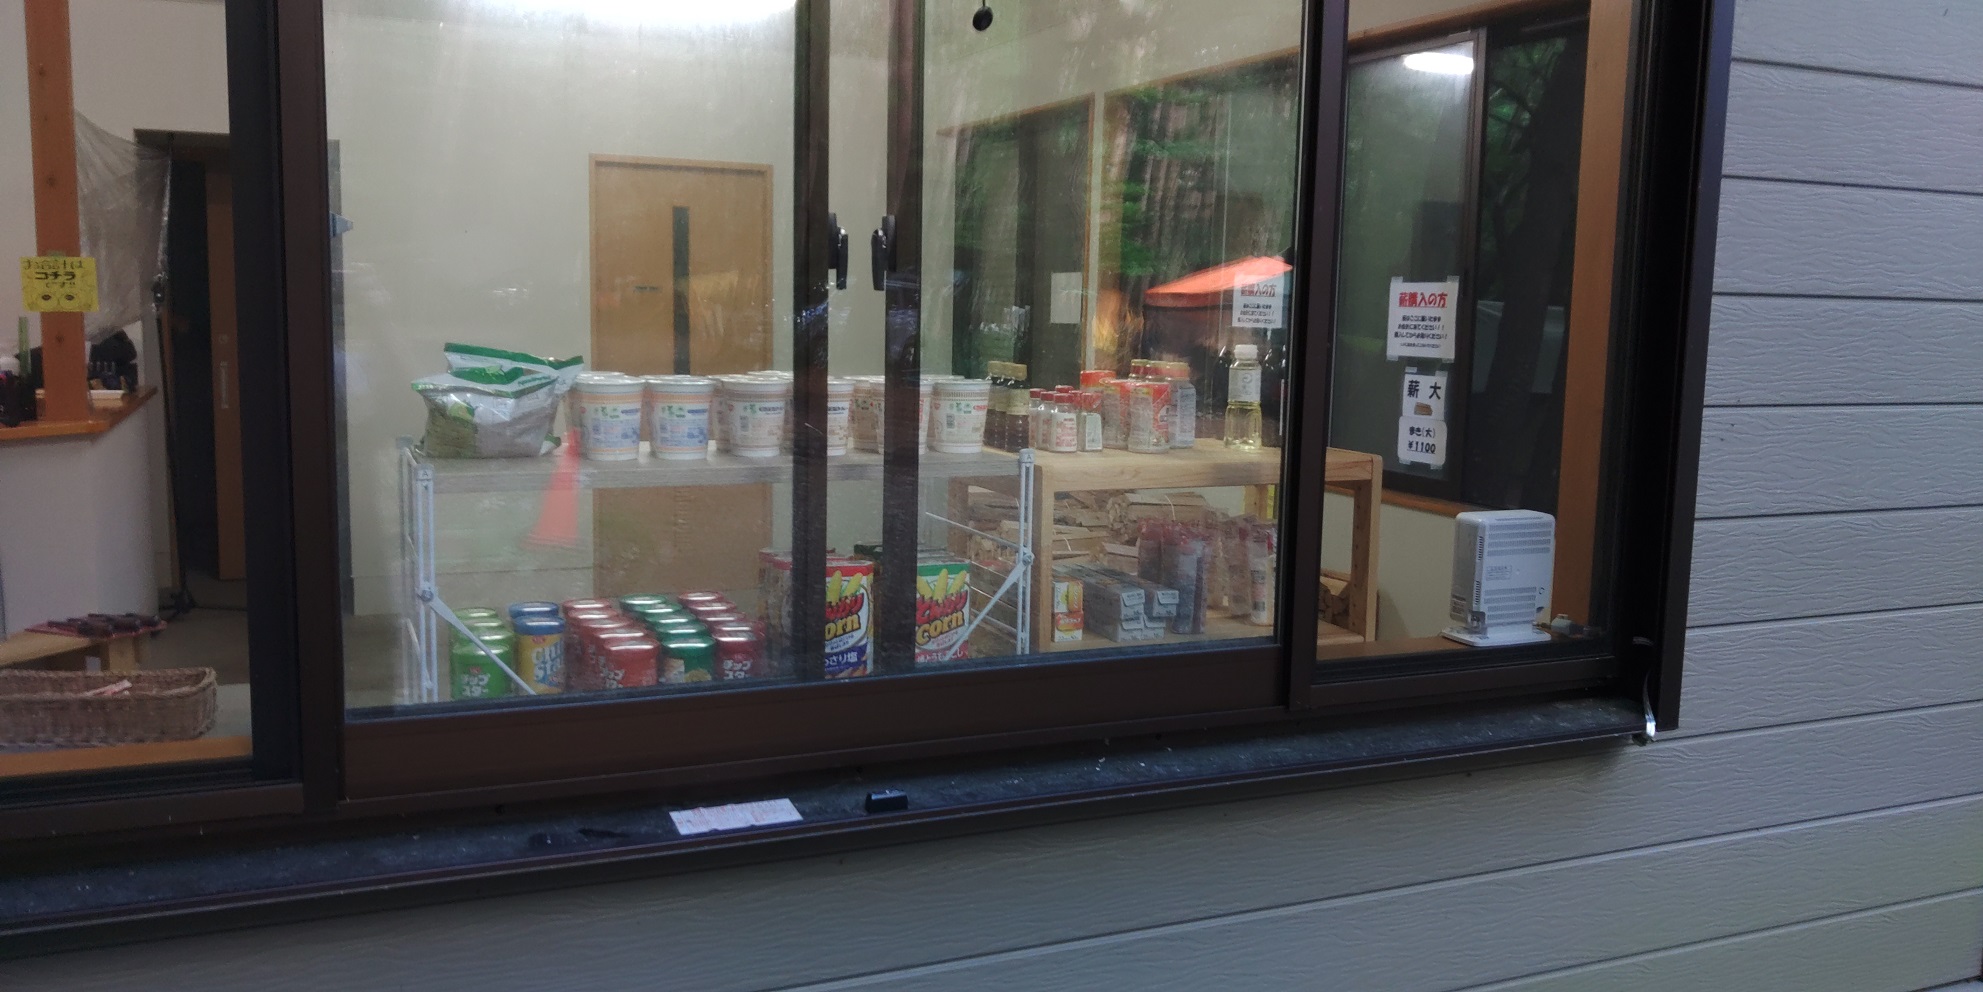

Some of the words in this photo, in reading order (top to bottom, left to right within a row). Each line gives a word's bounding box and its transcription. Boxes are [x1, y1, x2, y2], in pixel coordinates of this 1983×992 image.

[34, 271, 76, 281] コチラ
[1399, 292, 1448, 308] 薪購入の方
[1407, 379, 1420, 398] 薪
[1428, 381, 1441, 400] 大
[1408, 440, 1436, 454] ¥1100
[825, 613, 861, 641] orn
[915, 610, 965, 646] Corn
